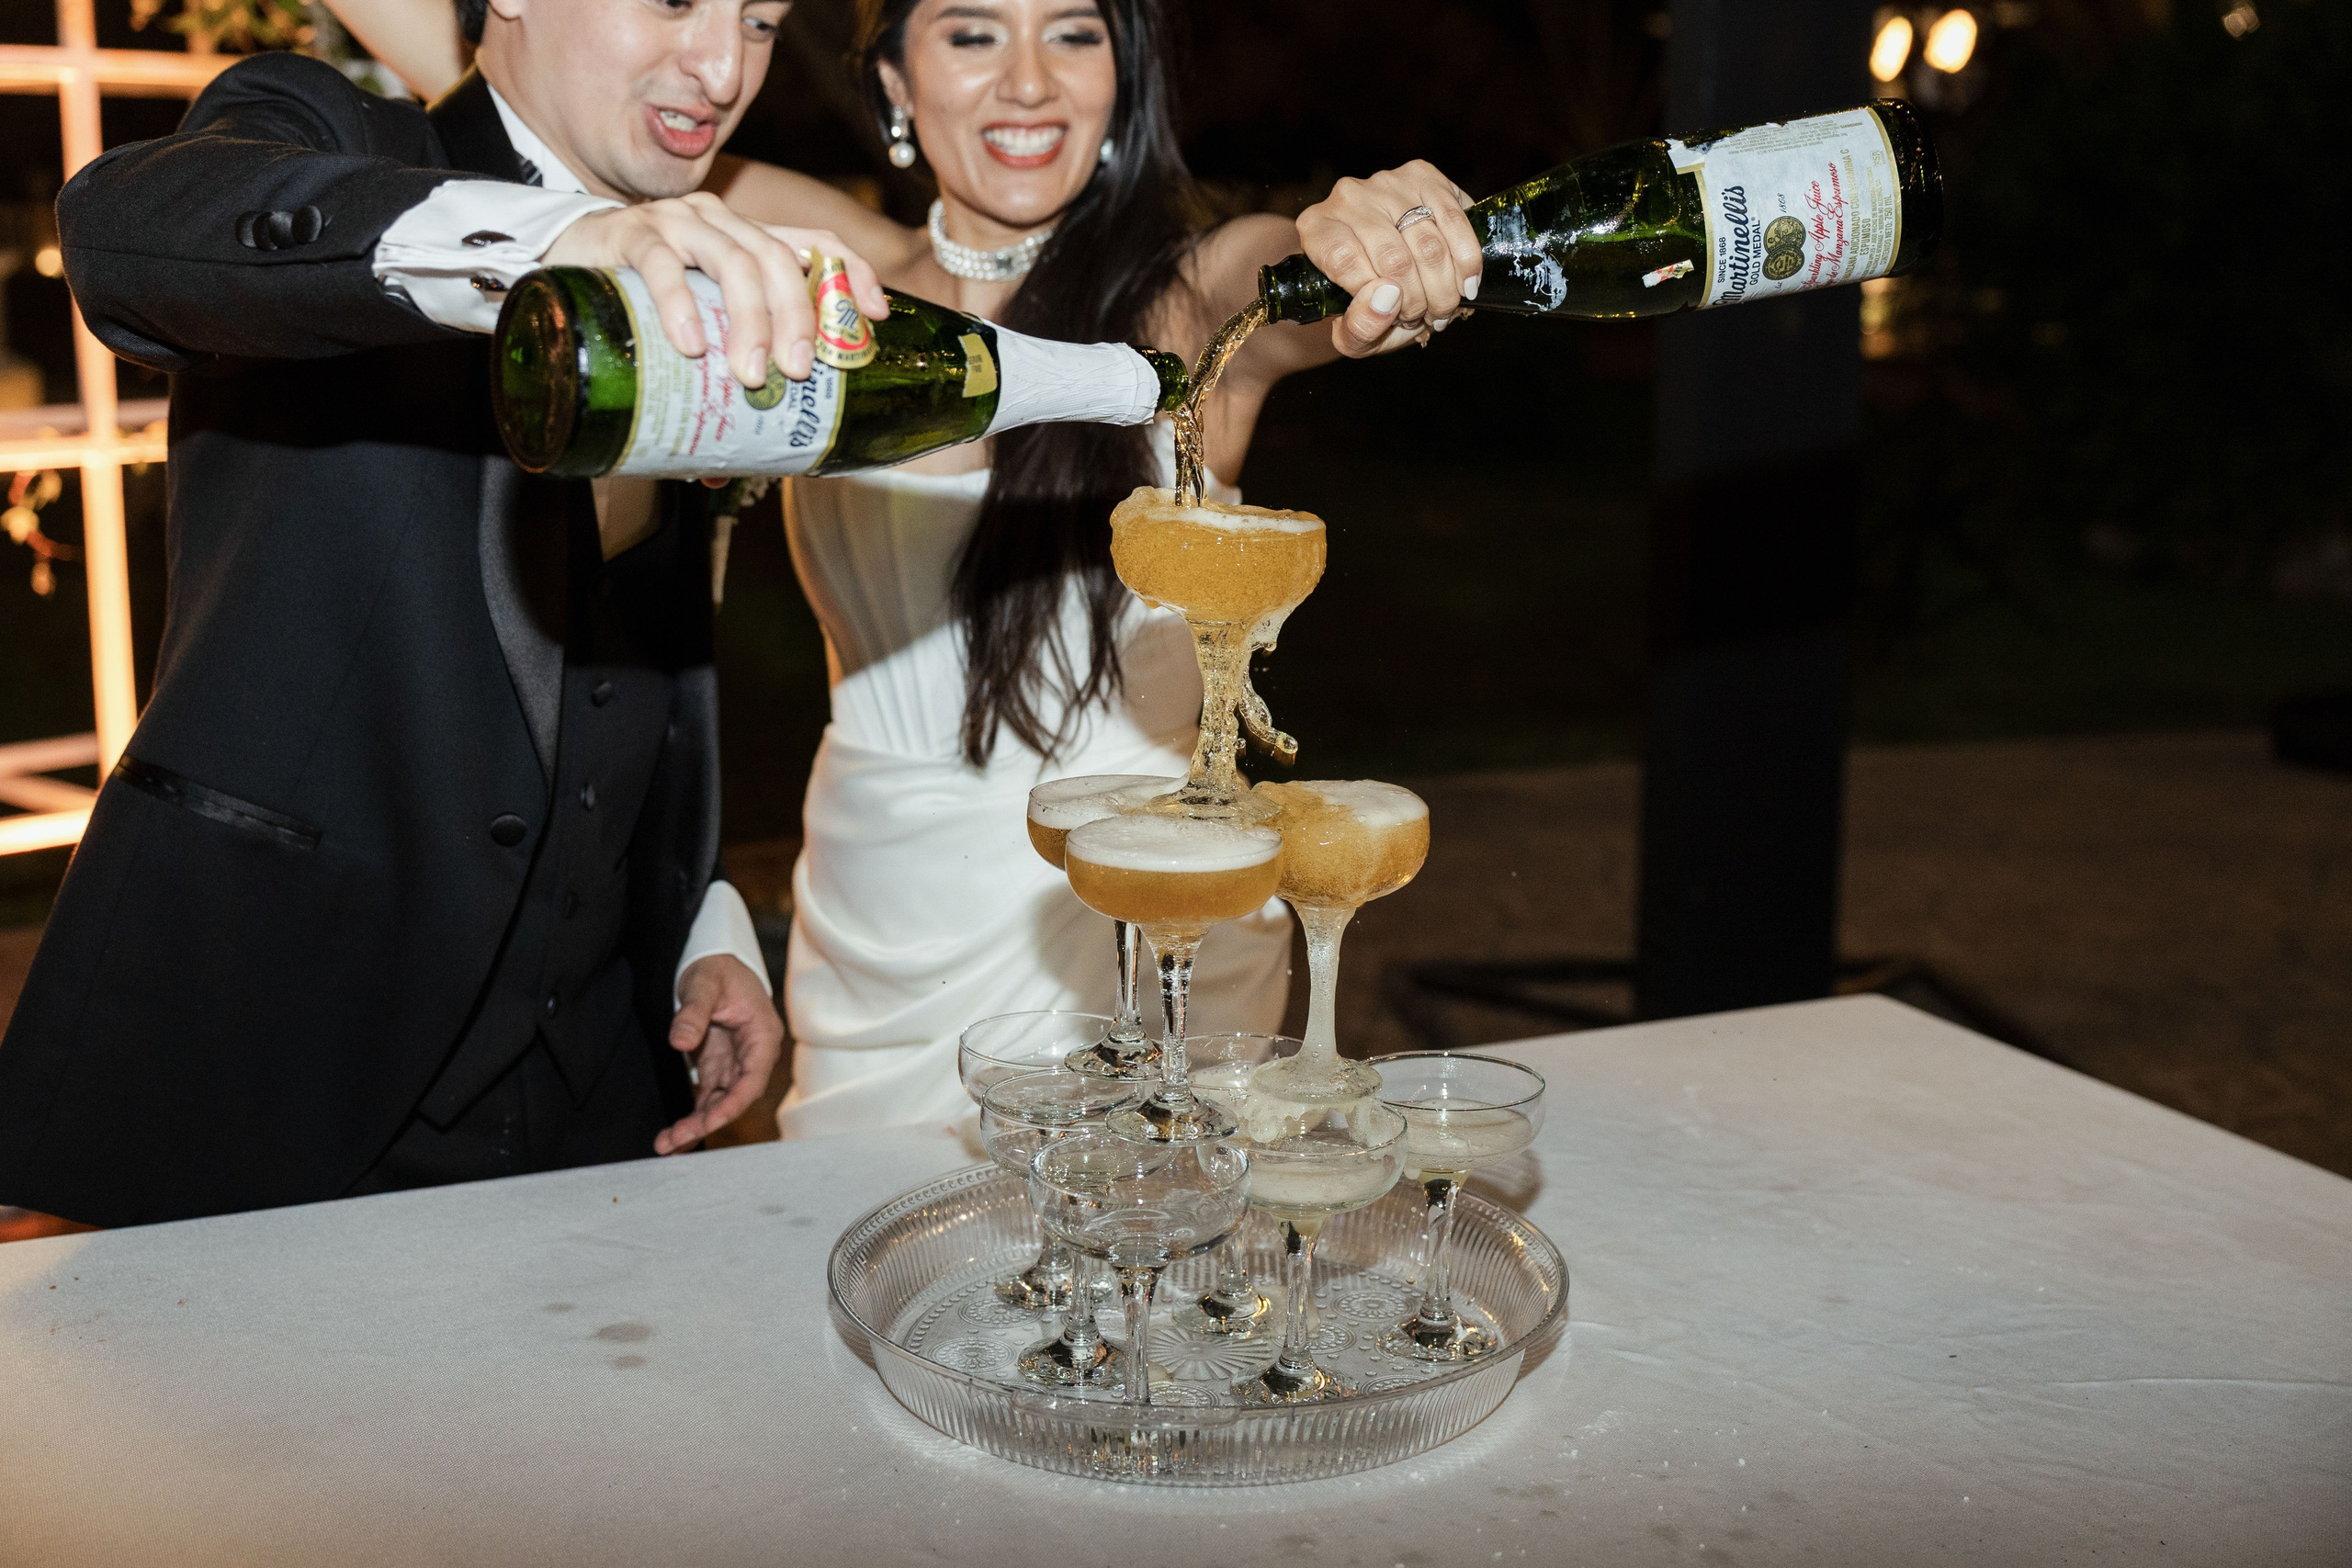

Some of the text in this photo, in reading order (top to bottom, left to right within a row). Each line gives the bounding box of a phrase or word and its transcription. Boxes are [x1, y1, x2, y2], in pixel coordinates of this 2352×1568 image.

[1776, 192, 1788, 213] 1868
[1803, 180, 1829, 216] Juice
[1826, 161, 1849, 220] Espumoso
[1807, 213, 1830, 252] Apple
[1849, 210, 1860, 255] ADICIONADO
[1883, 207, 1894, 221] 750
[1712, 185, 1751, 305] Martinelli's
[1826, 218, 1849, 272] Manzana
[1859, 218, 1871, 256] ESPUMOSO
[1717, 236, 1726, 284] SINCE 1868
[1749, 261, 1761, 286] GOLD
